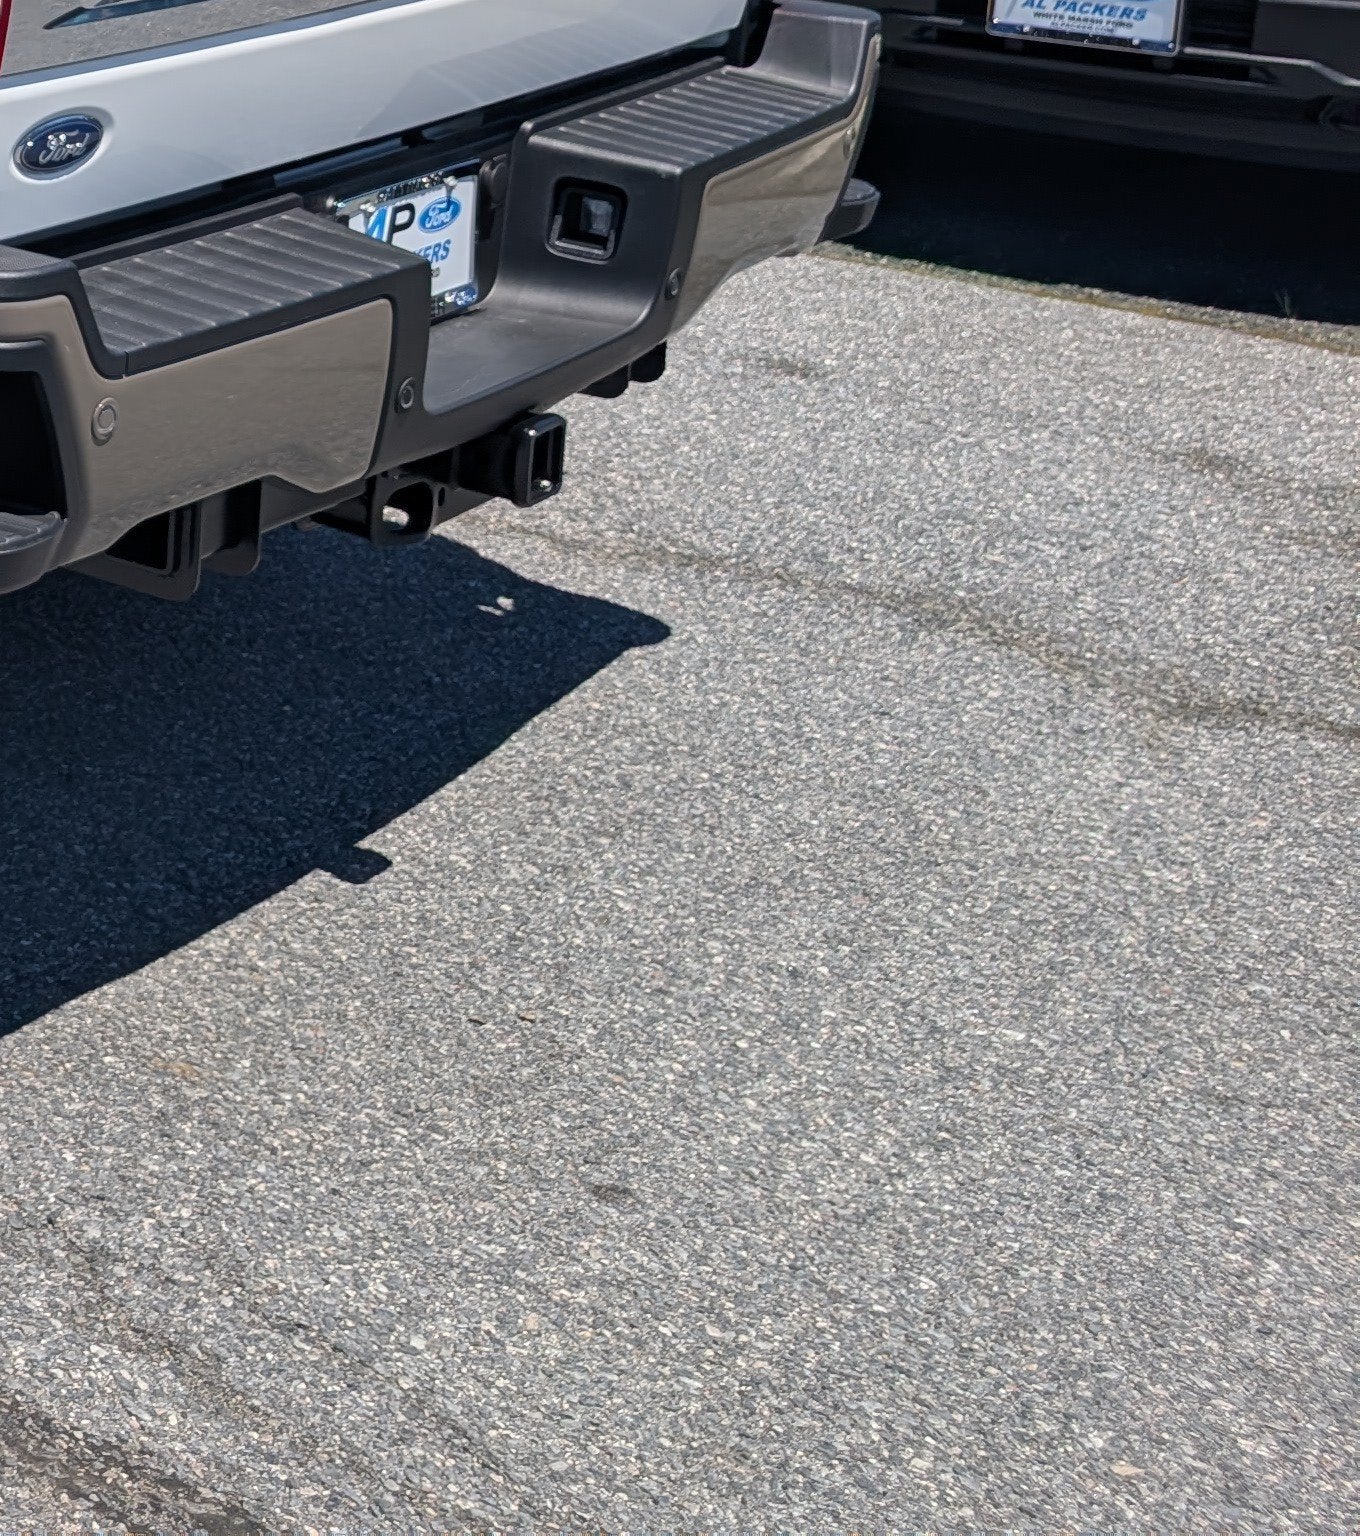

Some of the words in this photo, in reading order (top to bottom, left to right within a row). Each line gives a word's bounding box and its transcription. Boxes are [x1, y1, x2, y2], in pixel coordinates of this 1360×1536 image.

[1053, 0, 1149, 22] PACKERS
[38, 128, 90, 165] Ford
[424, 199, 456, 229] Ford
